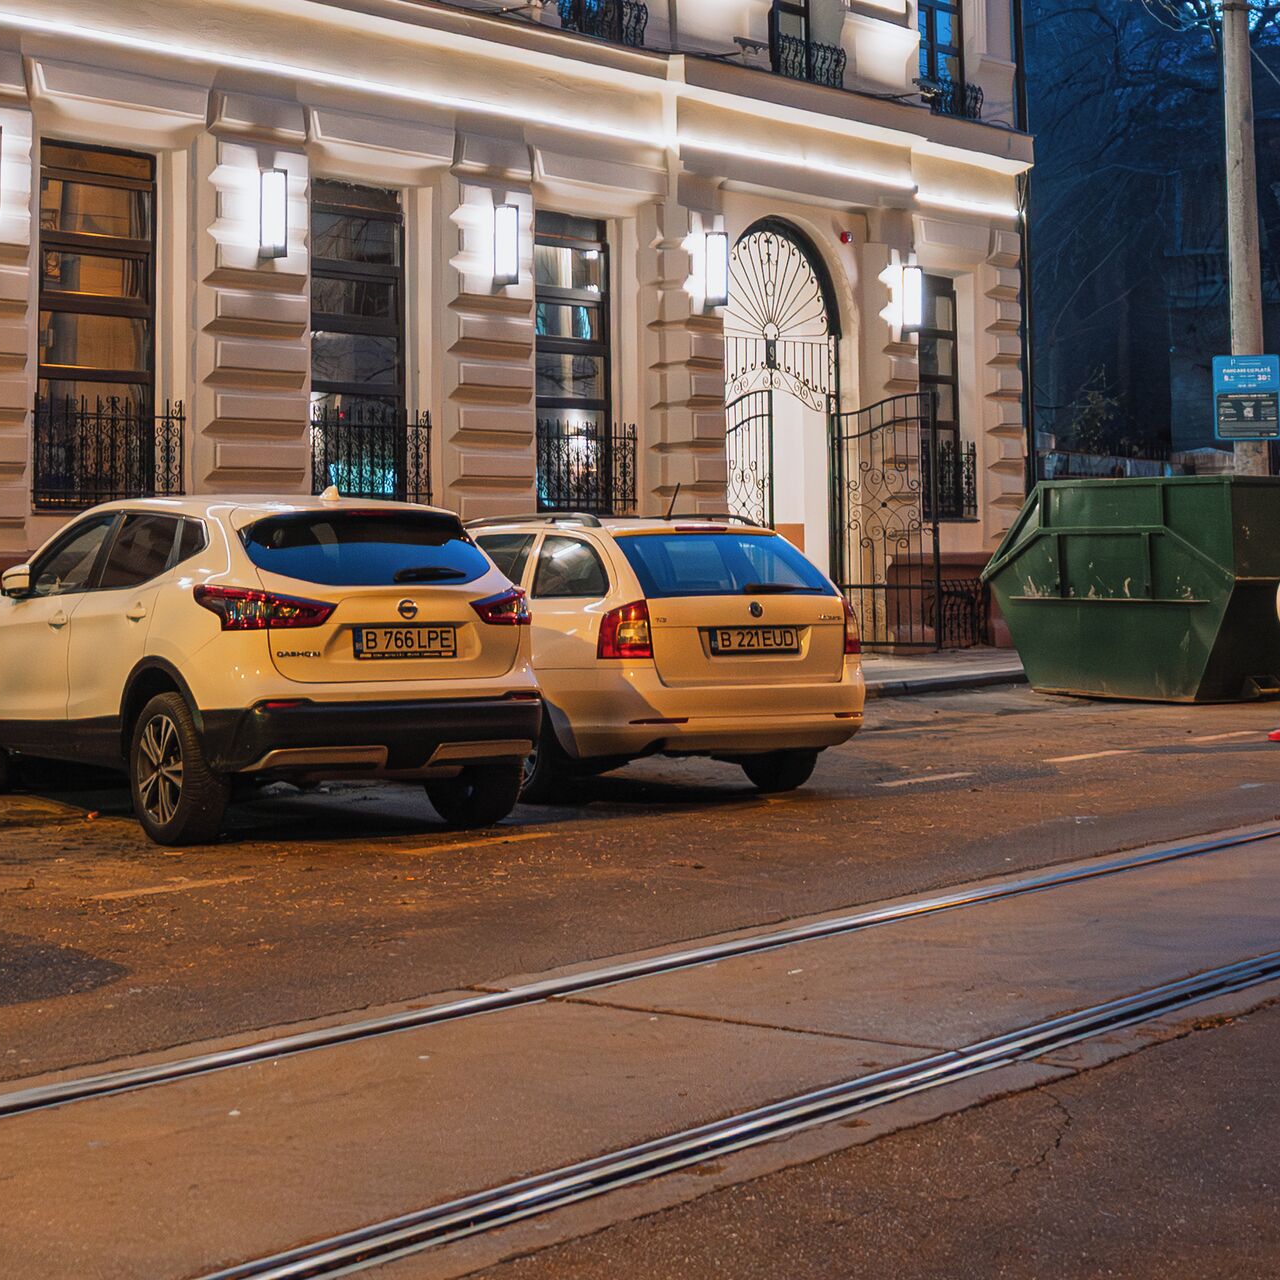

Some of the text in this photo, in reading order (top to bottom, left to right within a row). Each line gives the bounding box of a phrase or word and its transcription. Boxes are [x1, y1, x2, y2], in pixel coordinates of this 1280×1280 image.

[366, 631, 377, 649] B
[384, 631, 414, 649] 766
[417, 630, 452, 648] LPE
[721, 631, 731, 648] B
[737, 631, 759, 647] 221
[762, 629, 793, 646] EUD
